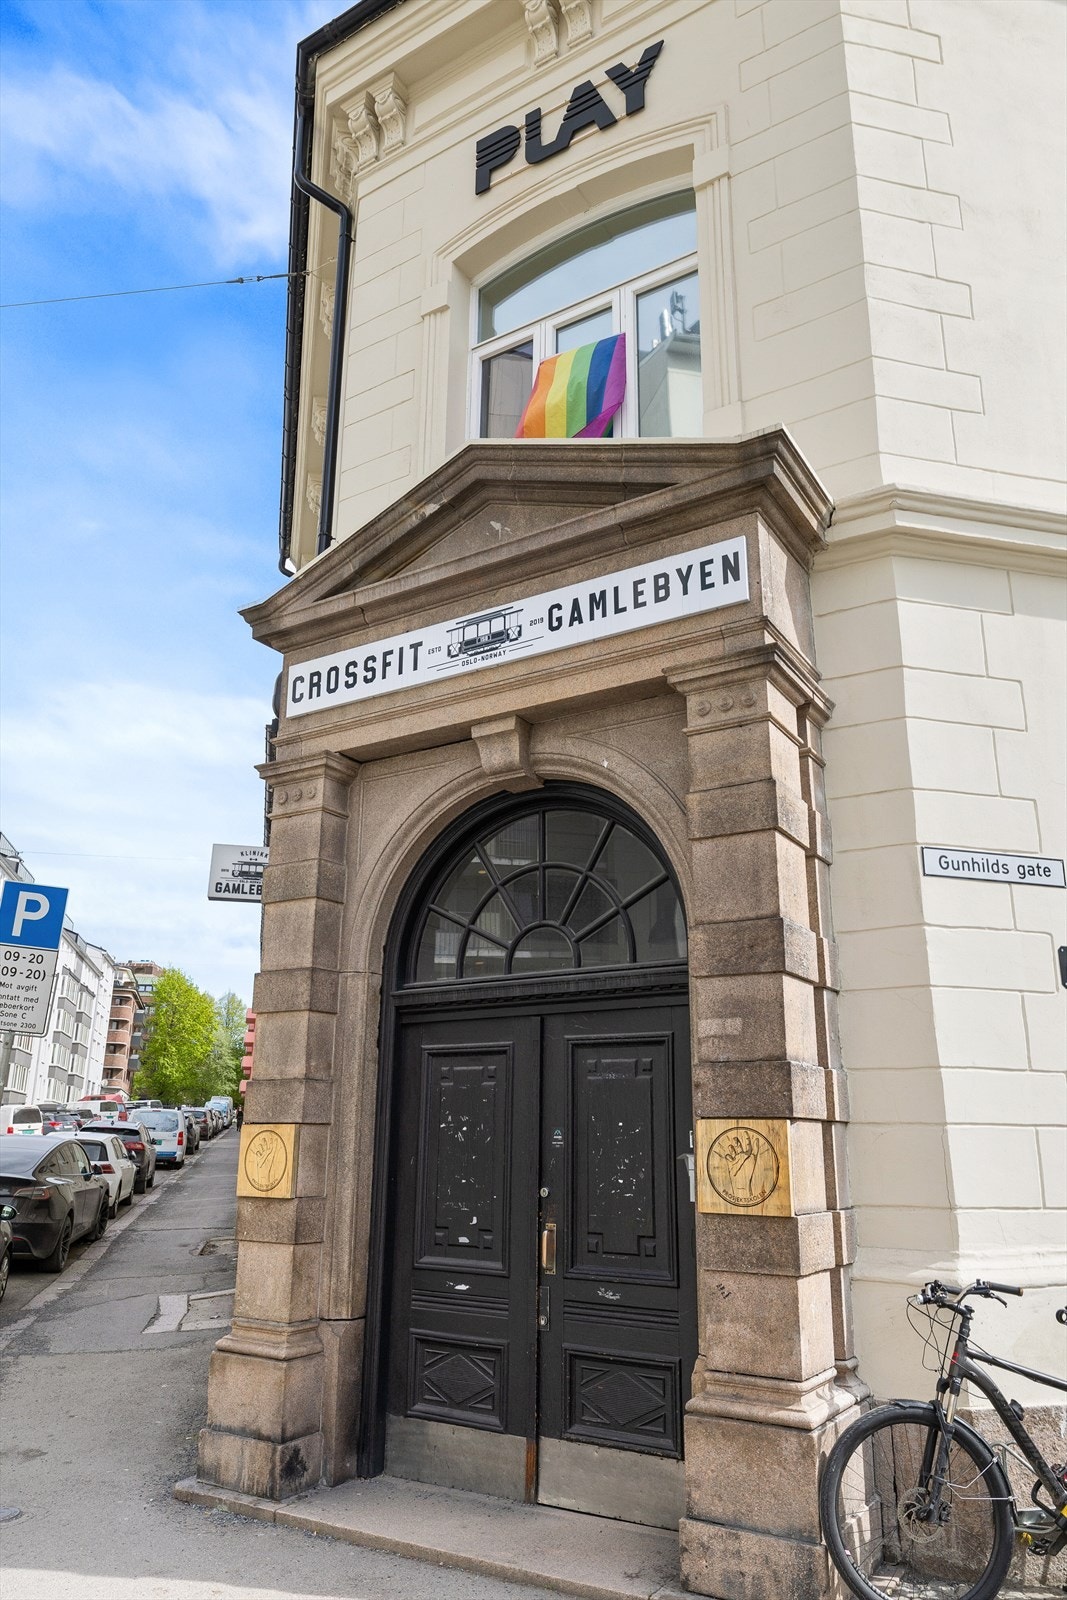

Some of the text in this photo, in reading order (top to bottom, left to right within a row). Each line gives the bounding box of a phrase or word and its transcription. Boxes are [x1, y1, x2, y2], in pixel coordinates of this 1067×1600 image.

[475, 39, 664, 195] PLAY
[291, 551, 741, 704] CROSSFIT GAMLEBYEN
[427, 617, 544, 655] ESTD 2019
[461, 649, 507, 667] OSLO-NORWAY
[938, 854, 1052, 880] Gunhilds gate
[12, 890, 50, 937] P
[0, 965, 46, 982] 09-20)
[16, 984, 38, 993] avgift
[23, 996, 39, 1004] med
[0, 1010, 27, 1020] Sone C
[20, 1021, 37, 1030] 2300
